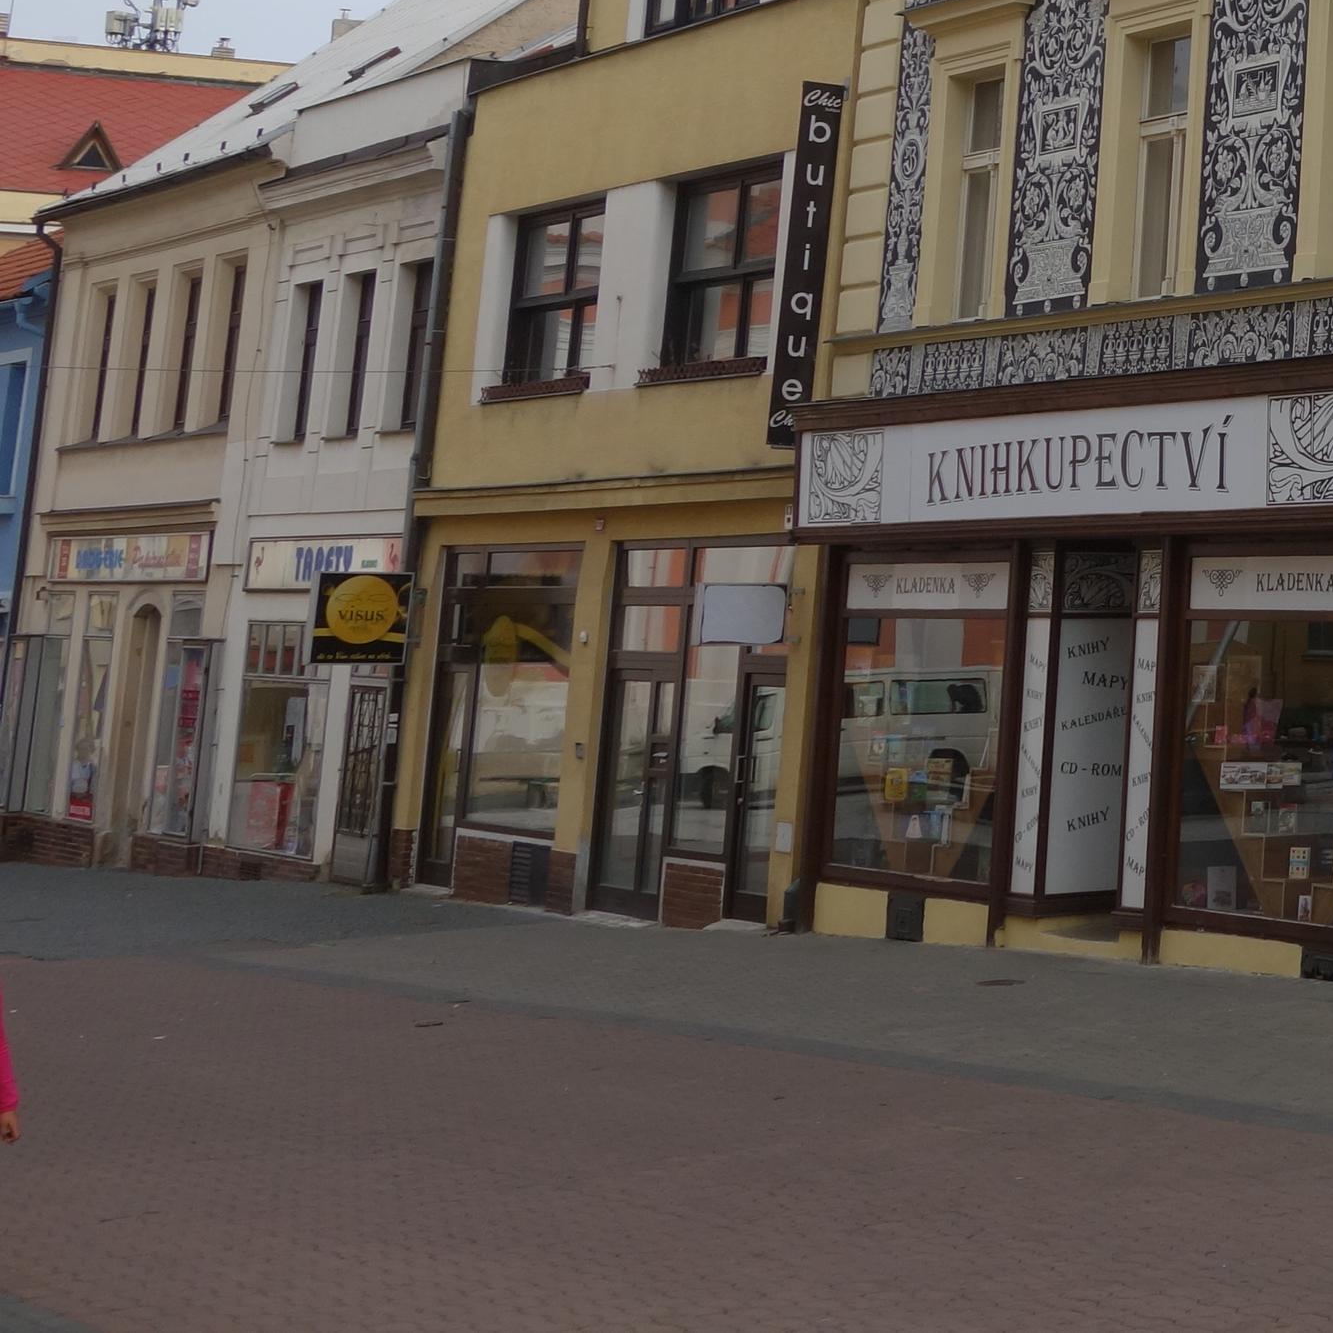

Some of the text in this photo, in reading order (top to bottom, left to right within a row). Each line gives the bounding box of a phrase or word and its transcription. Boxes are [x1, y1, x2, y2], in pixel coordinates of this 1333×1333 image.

[803, 89, 842, 108] Chic
[781, 115, 832, 401] butique
[926, 414, 1234, 506] KNIHKUPECTVÍ
[896, 577, 955, 594] KLADENKA
[338, 605, 385, 622] visus
[1067, 637, 1110, 659] KNIHY
[1137, 658, 1156, 673] MAP
[1082, 671, 1128, 691] MAPY
[1061, 761, 1078, 774] CD
[1091, 762, 1123, 777] ROM
[1067, 807, 1110, 832] KNIHY
